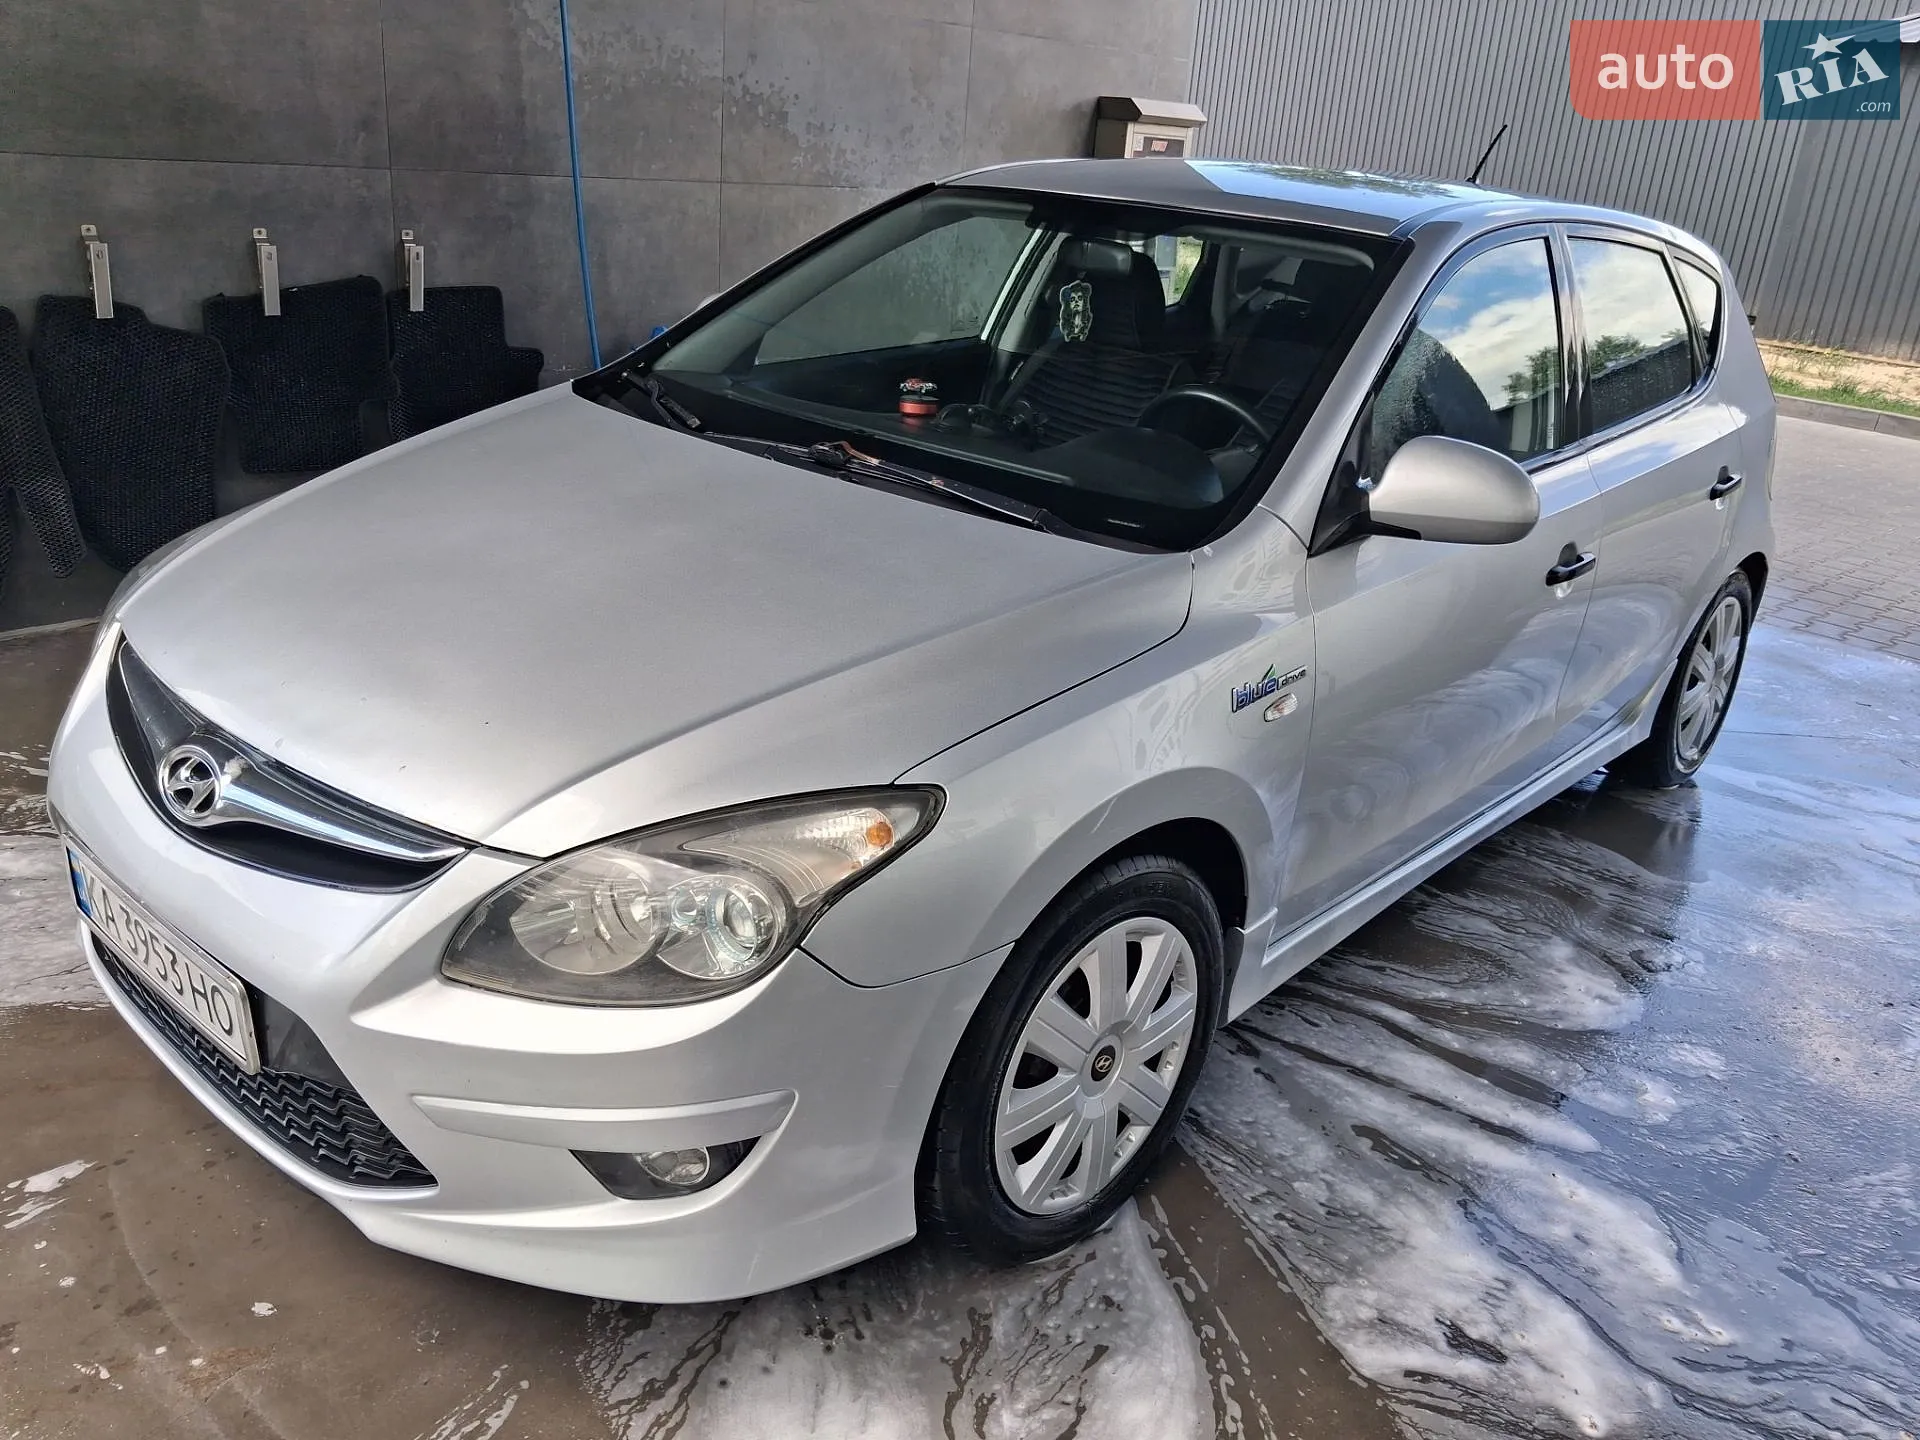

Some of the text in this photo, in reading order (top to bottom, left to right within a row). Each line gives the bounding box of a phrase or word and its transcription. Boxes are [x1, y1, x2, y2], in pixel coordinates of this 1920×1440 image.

[1232, 668, 1307, 713] blue drive
[82, 865, 233, 1036] KA 3953 HO
